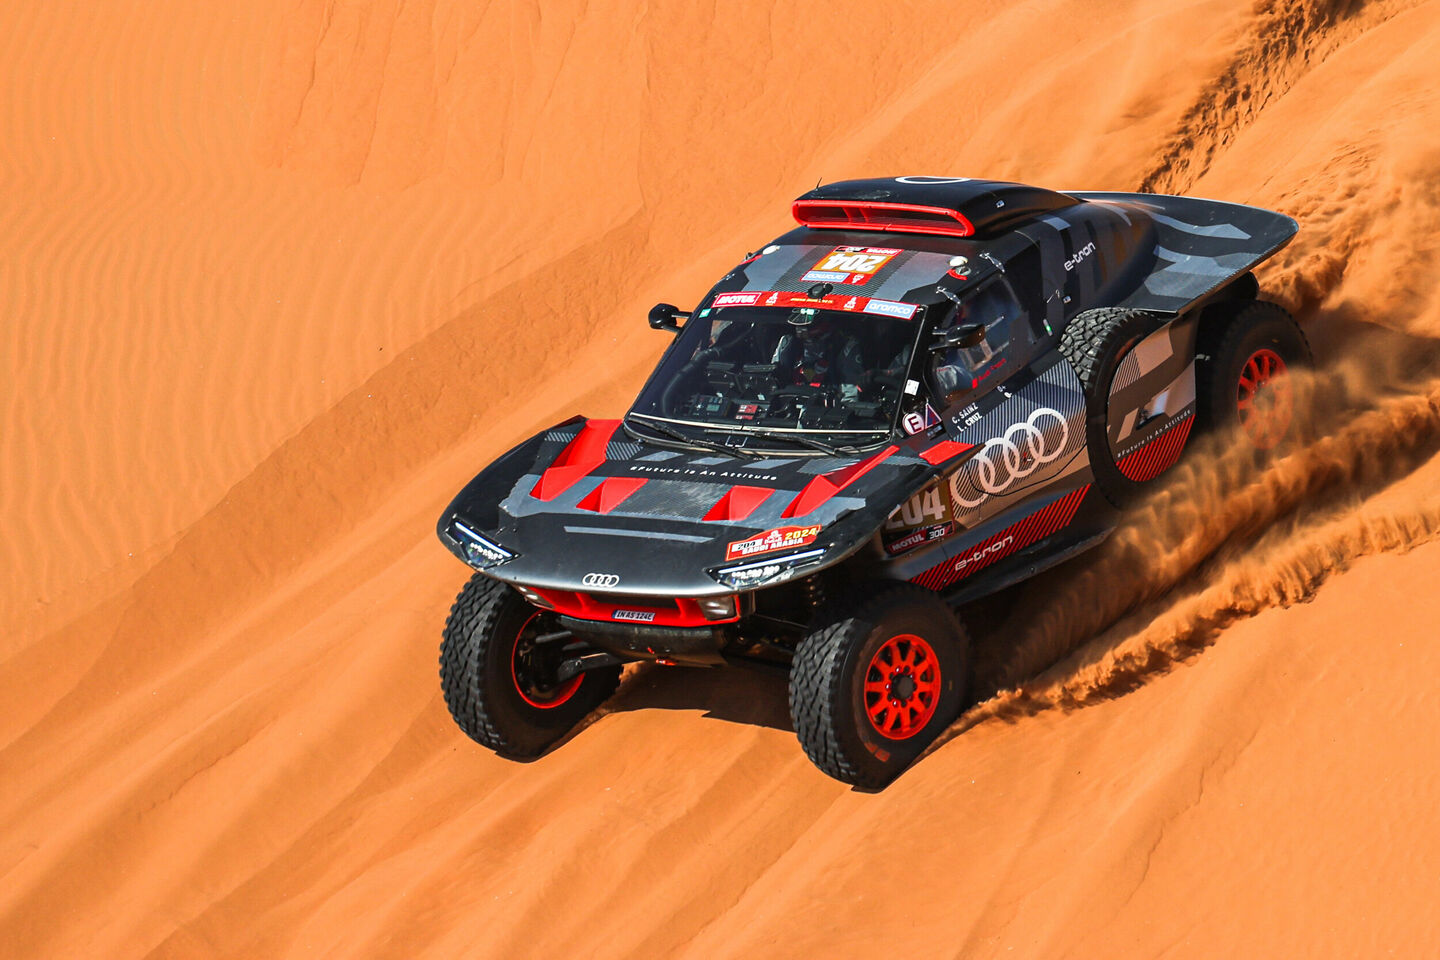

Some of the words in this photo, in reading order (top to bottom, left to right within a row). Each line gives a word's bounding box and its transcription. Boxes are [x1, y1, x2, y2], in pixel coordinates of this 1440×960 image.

[820, 253, 888, 272] 204
[1064, 241, 1096, 271] e-tron
[716, 294, 756, 305] MOTUL
[869, 303, 911, 315] aramco
[951, 416, 960, 424] C.
[959, 402, 979, 419] SAINZ
[957, 423, 967, 432] L.
[965, 411, 983, 427] CRUZ
[908, 415, 922, 432] E
[720, 471, 778, 481] Attitude
[784, 527, 818, 541] 2024
[892, 534, 925, 551] MOTUL
[929, 528, 946, 540] 300
[737, 541, 756, 550] 204
[741, 544, 769, 555] SAUDI
[770, 537, 804, 550] ARABIA
[955, 535, 1013, 571] e-tron
